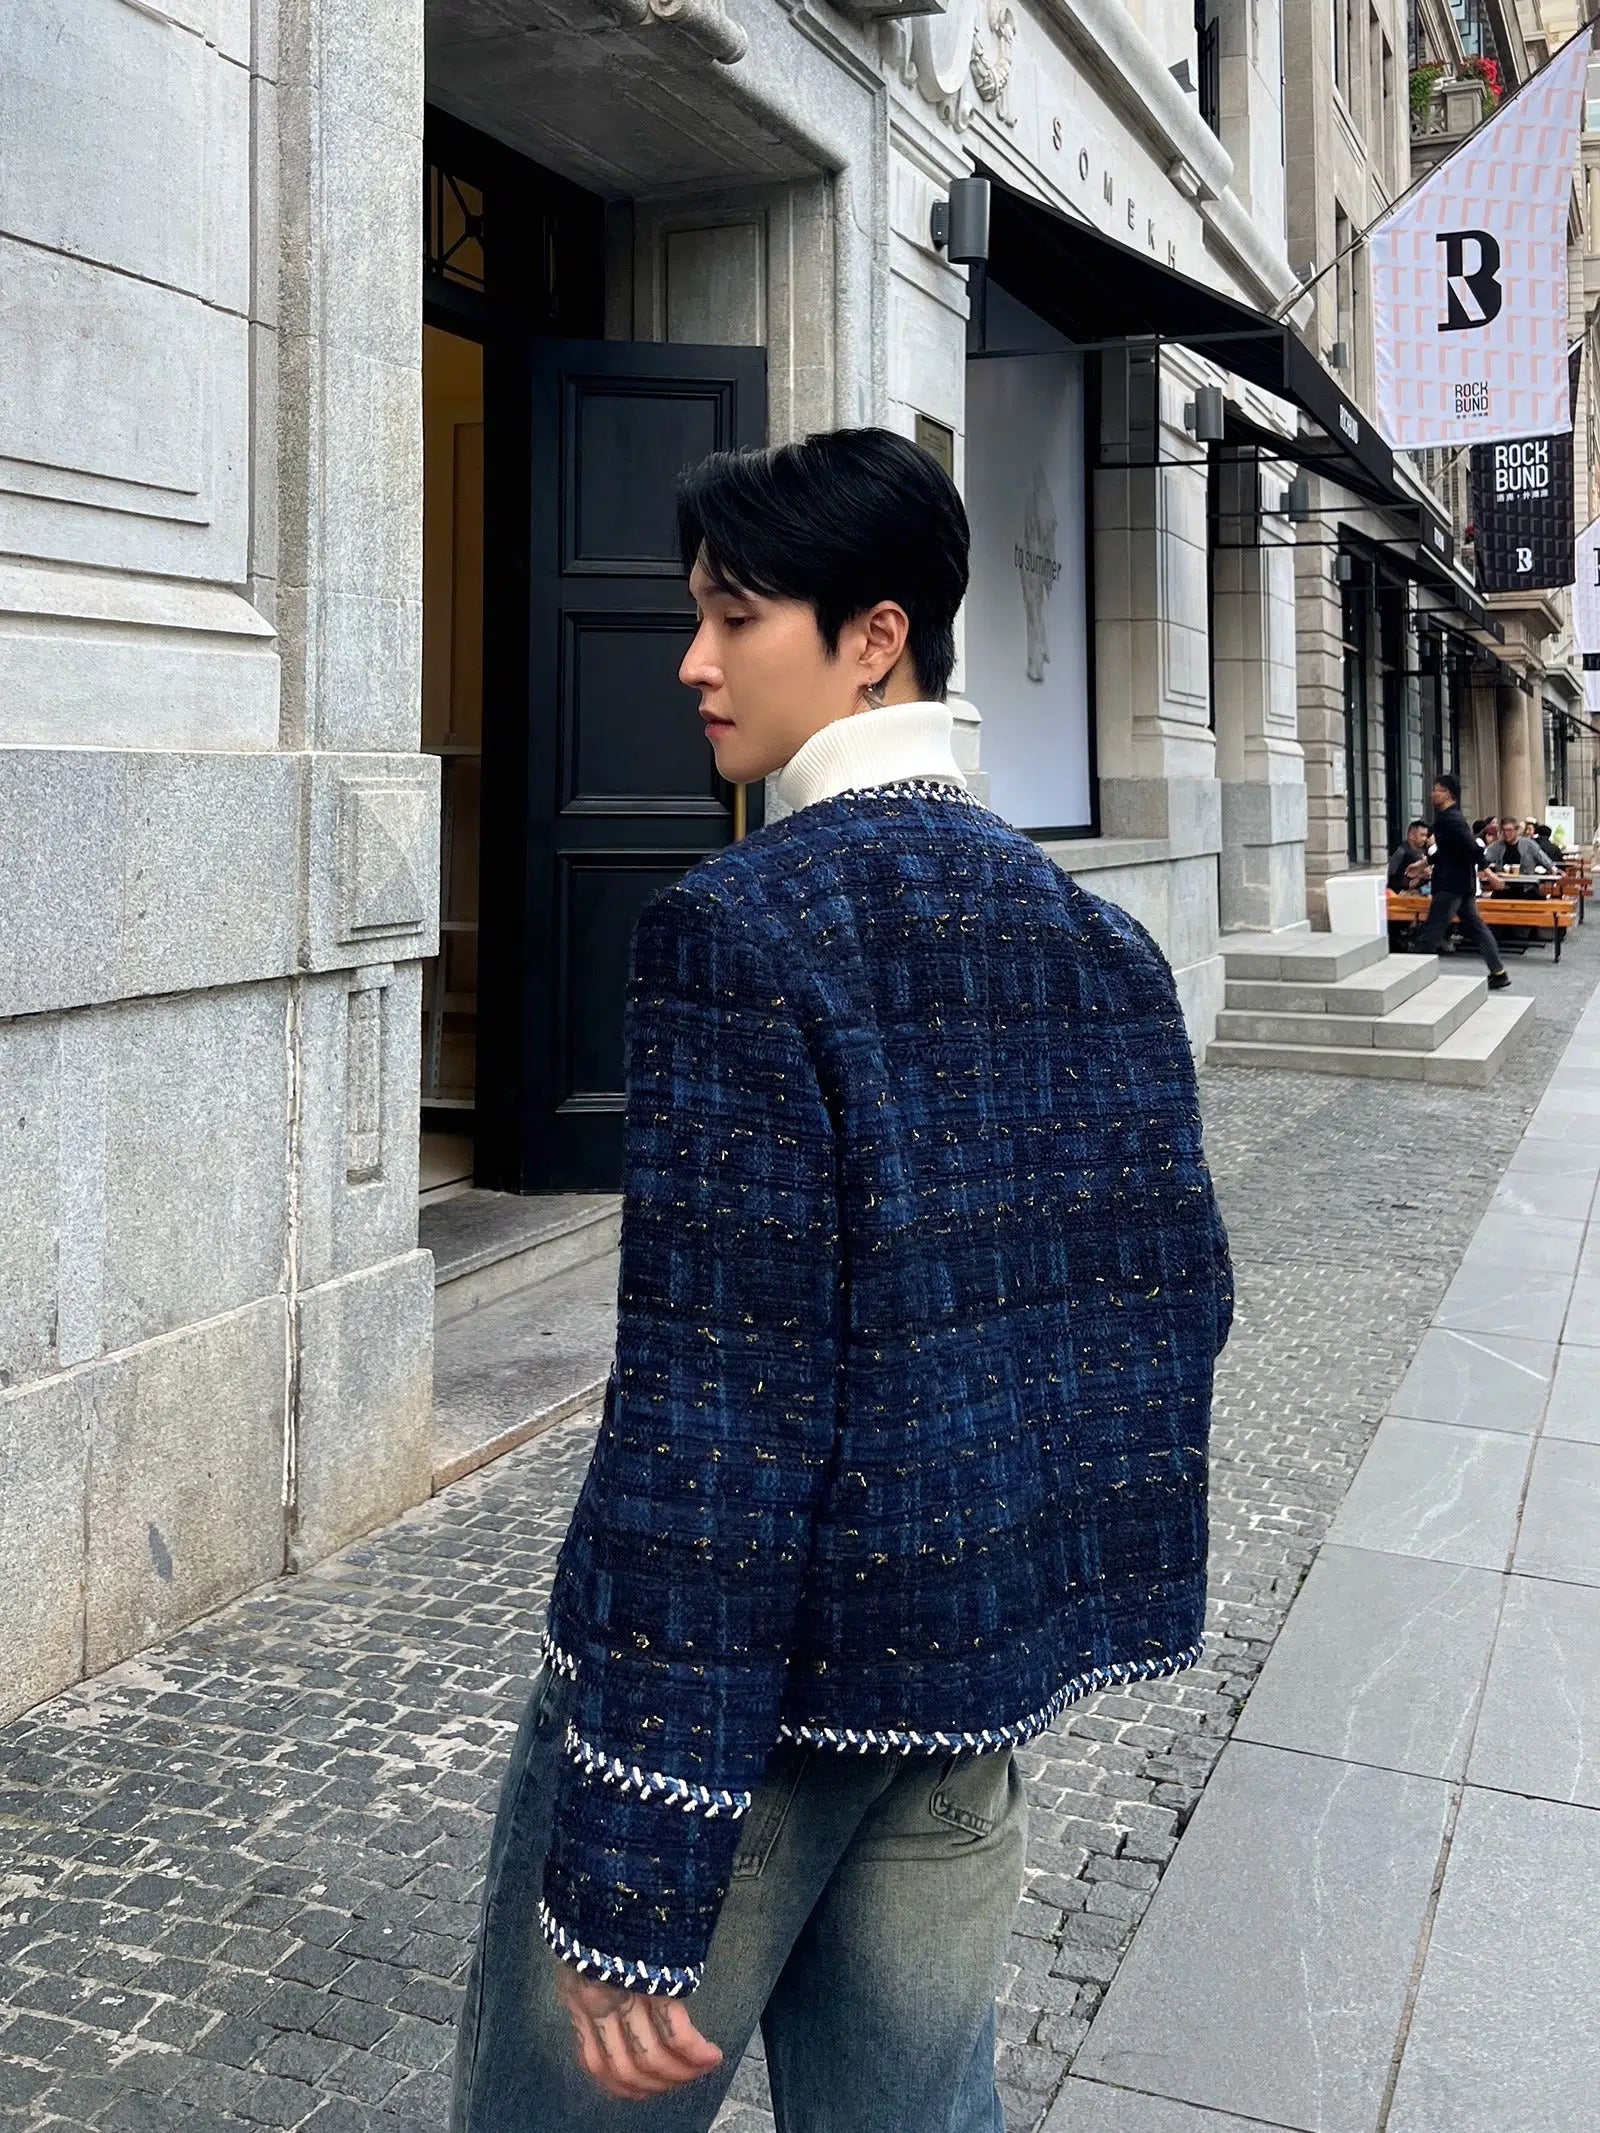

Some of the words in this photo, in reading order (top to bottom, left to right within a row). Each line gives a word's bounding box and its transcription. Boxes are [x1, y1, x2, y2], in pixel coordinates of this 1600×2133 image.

[1052, 117, 1176, 269] SOMEKH
[1454, 381, 1489, 398] ROCK
[1455, 396, 1489, 413] BUND
[1494, 440, 1549, 469] ROCK
[1495, 464, 1549, 492] BUND
[1014, 541, 1024, 569] to
[1024, 550, 1062, 582] summer
